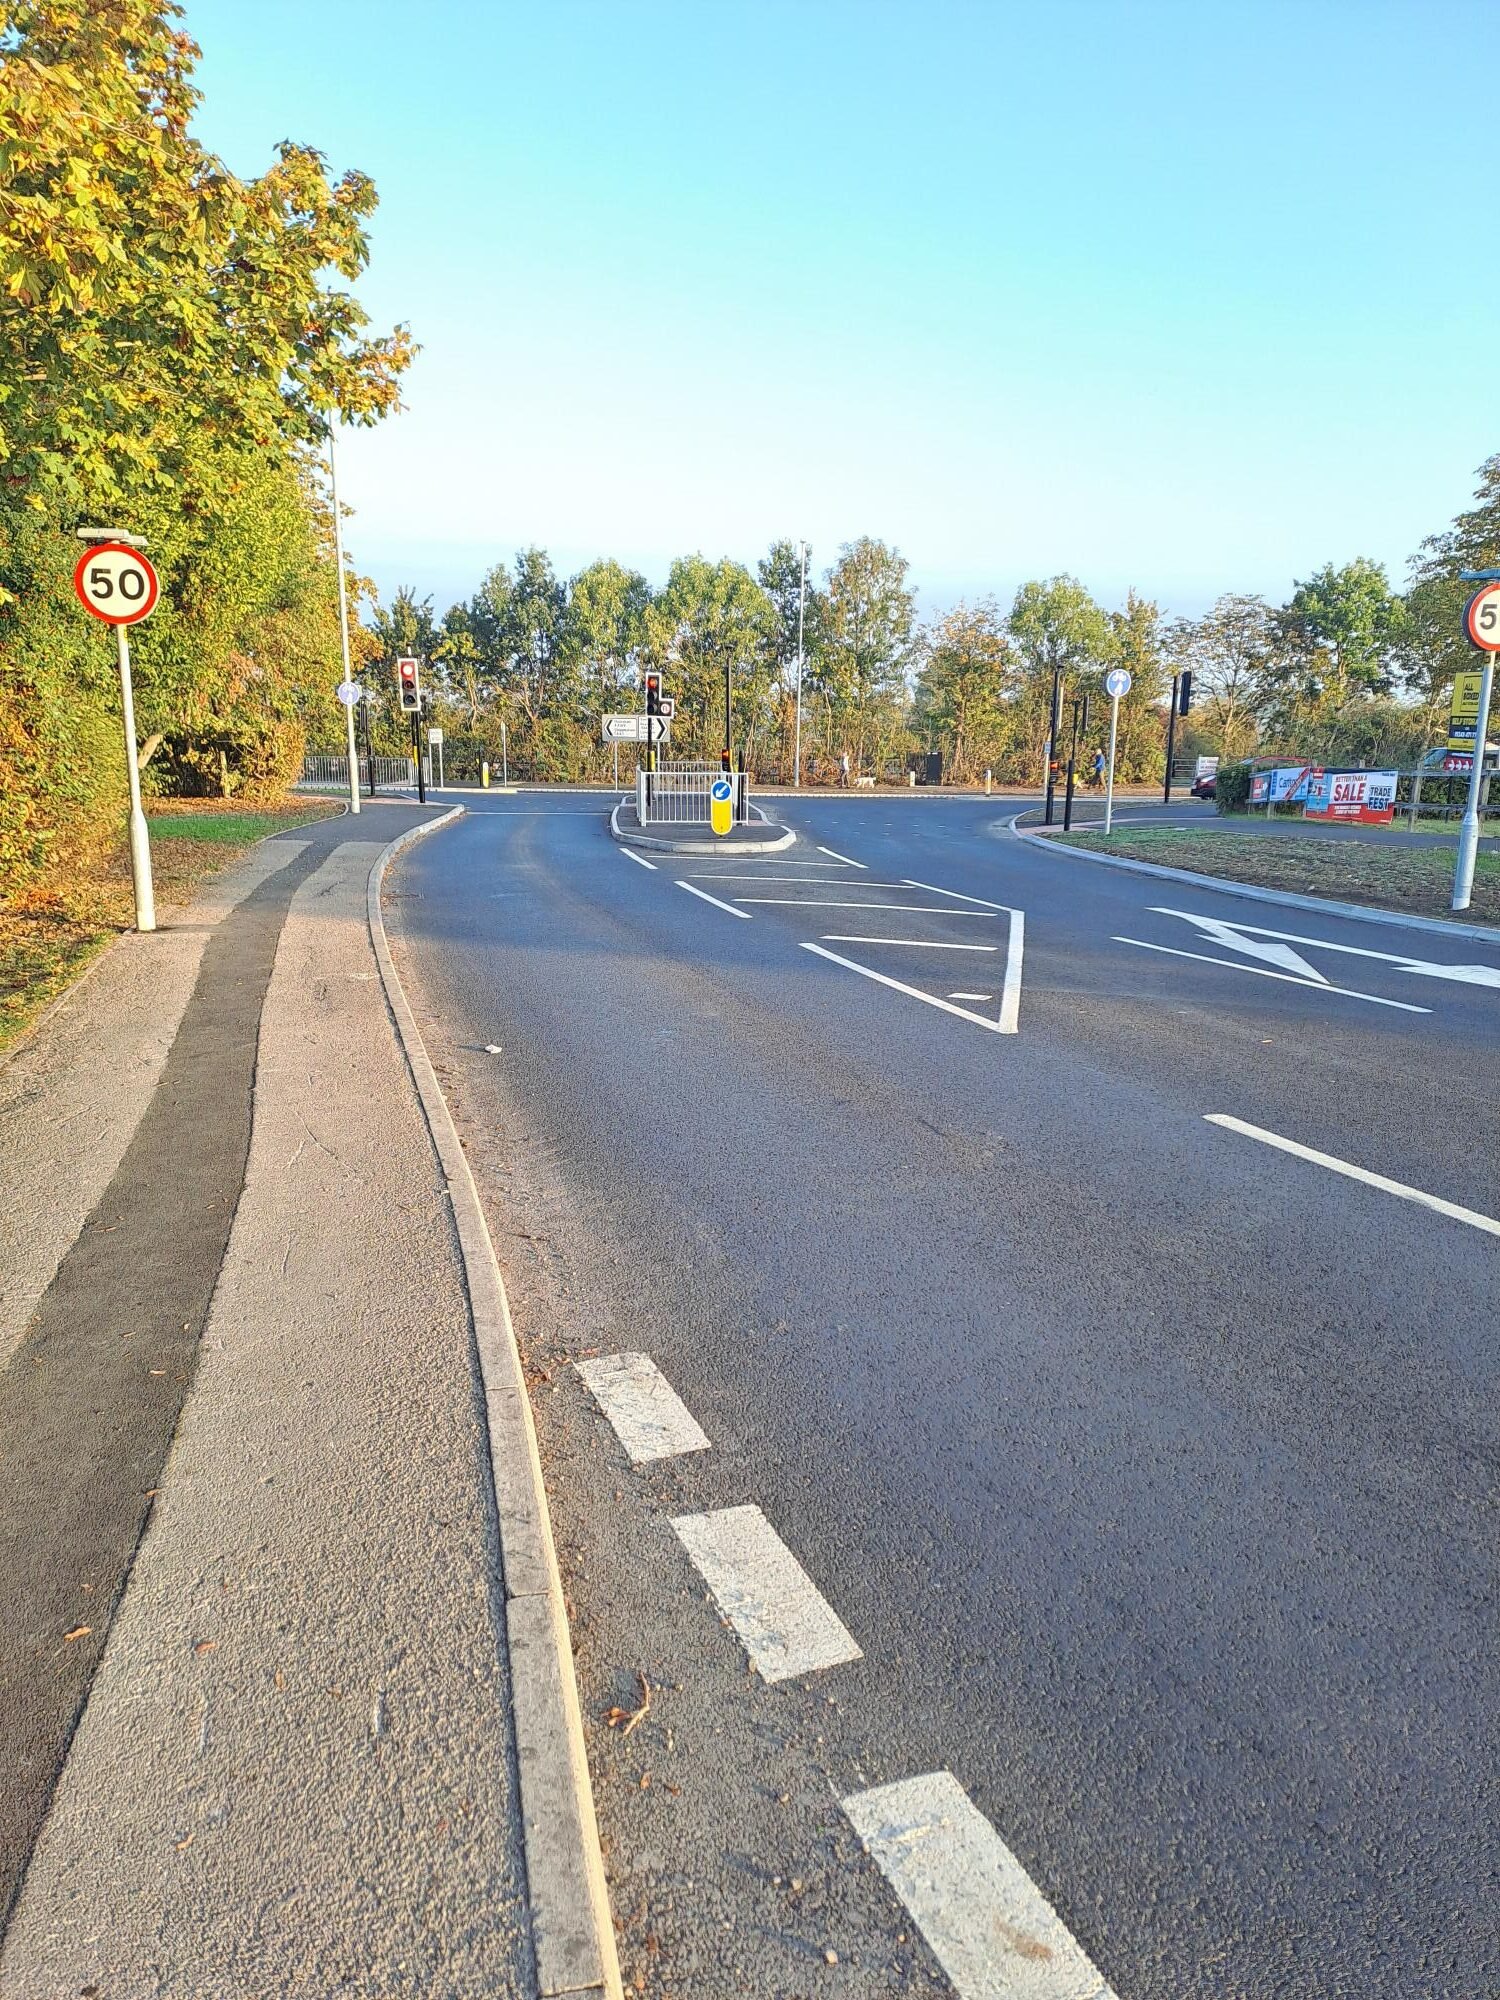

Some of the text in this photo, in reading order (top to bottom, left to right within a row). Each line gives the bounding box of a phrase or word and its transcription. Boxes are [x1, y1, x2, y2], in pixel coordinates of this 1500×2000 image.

[91, 568, 145, 600] 50
[1480, 604, 1497, 630] 5
[1334, 783, 1366, 801] SALE
[1371, 787, 1392, 797] TRADE
[1369, 797, 1389, 810] FEST
